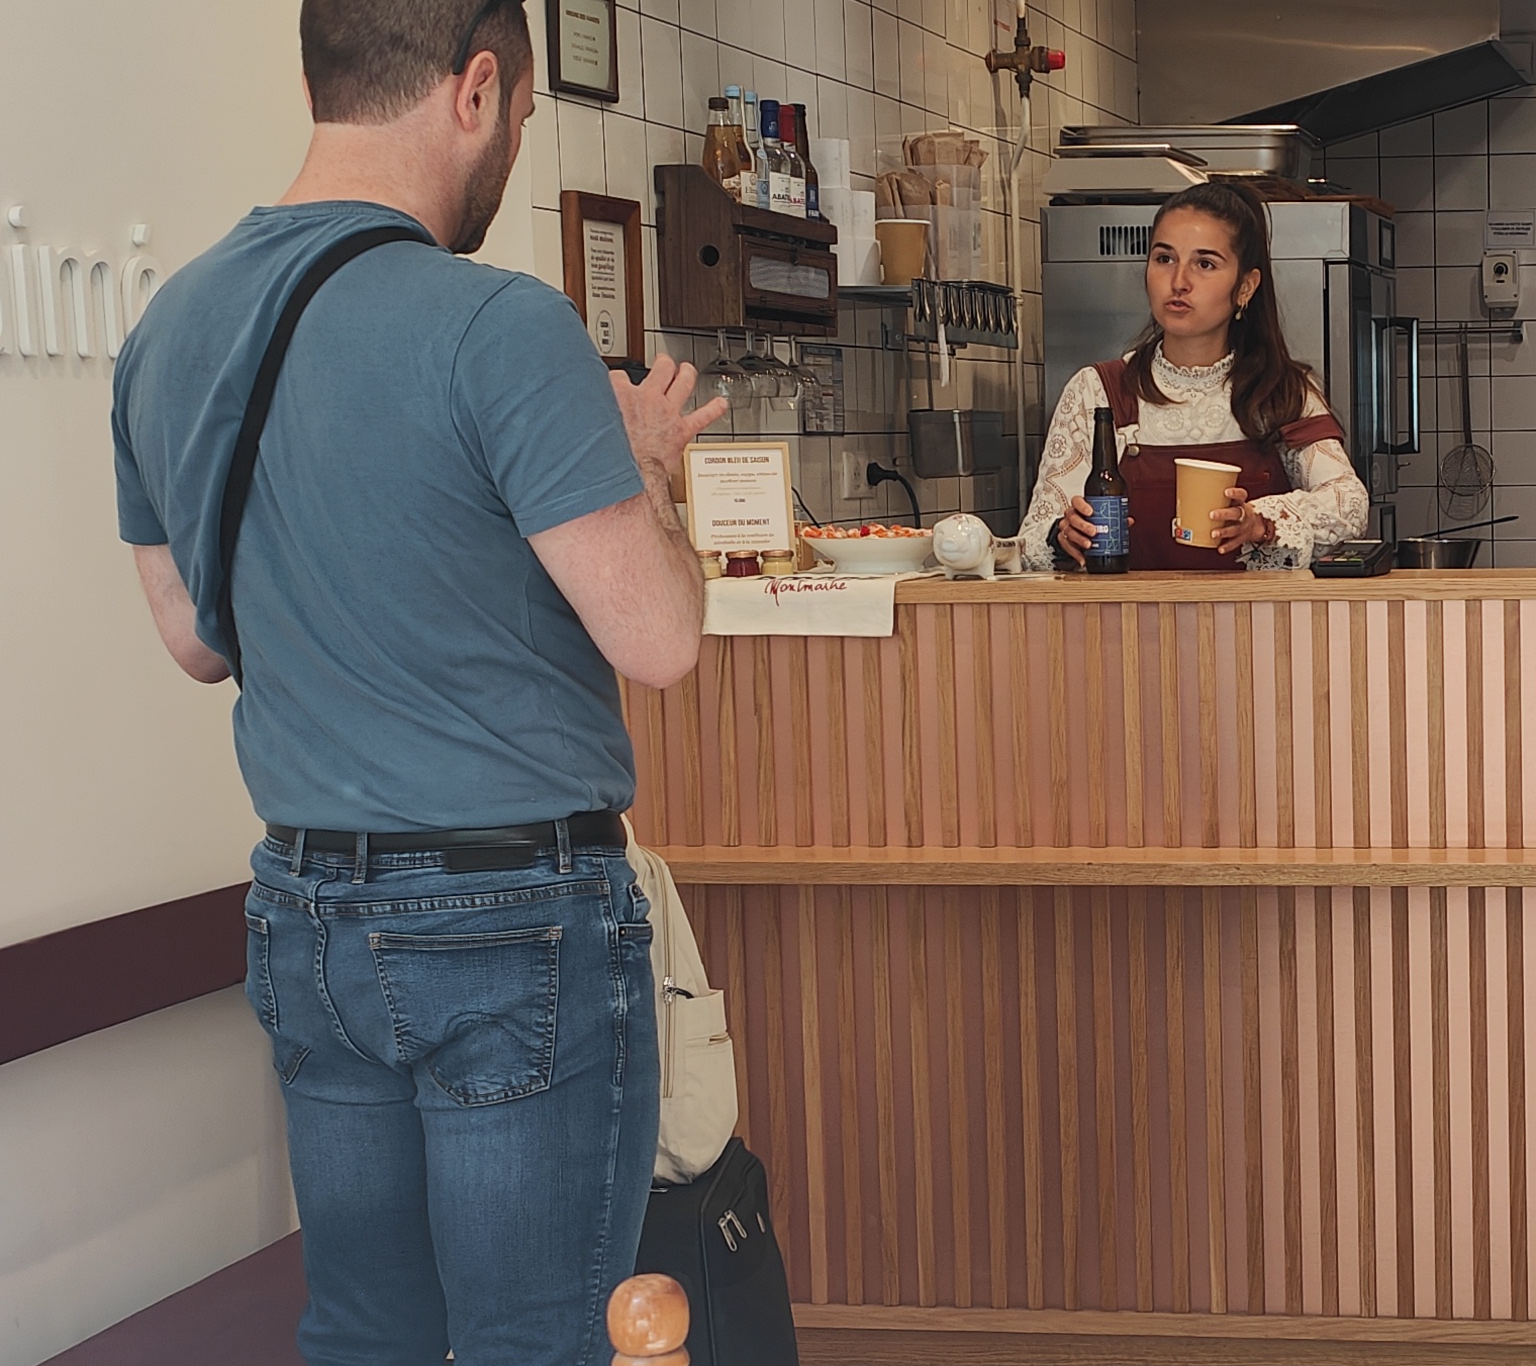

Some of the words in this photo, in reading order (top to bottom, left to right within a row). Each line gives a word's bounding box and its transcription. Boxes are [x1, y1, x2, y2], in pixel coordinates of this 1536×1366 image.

[712, 519, 737, 527] DOUCEUR
[746, 518, 770, 526] MOMENT
[764, 577, 847, 607] Montmartre
